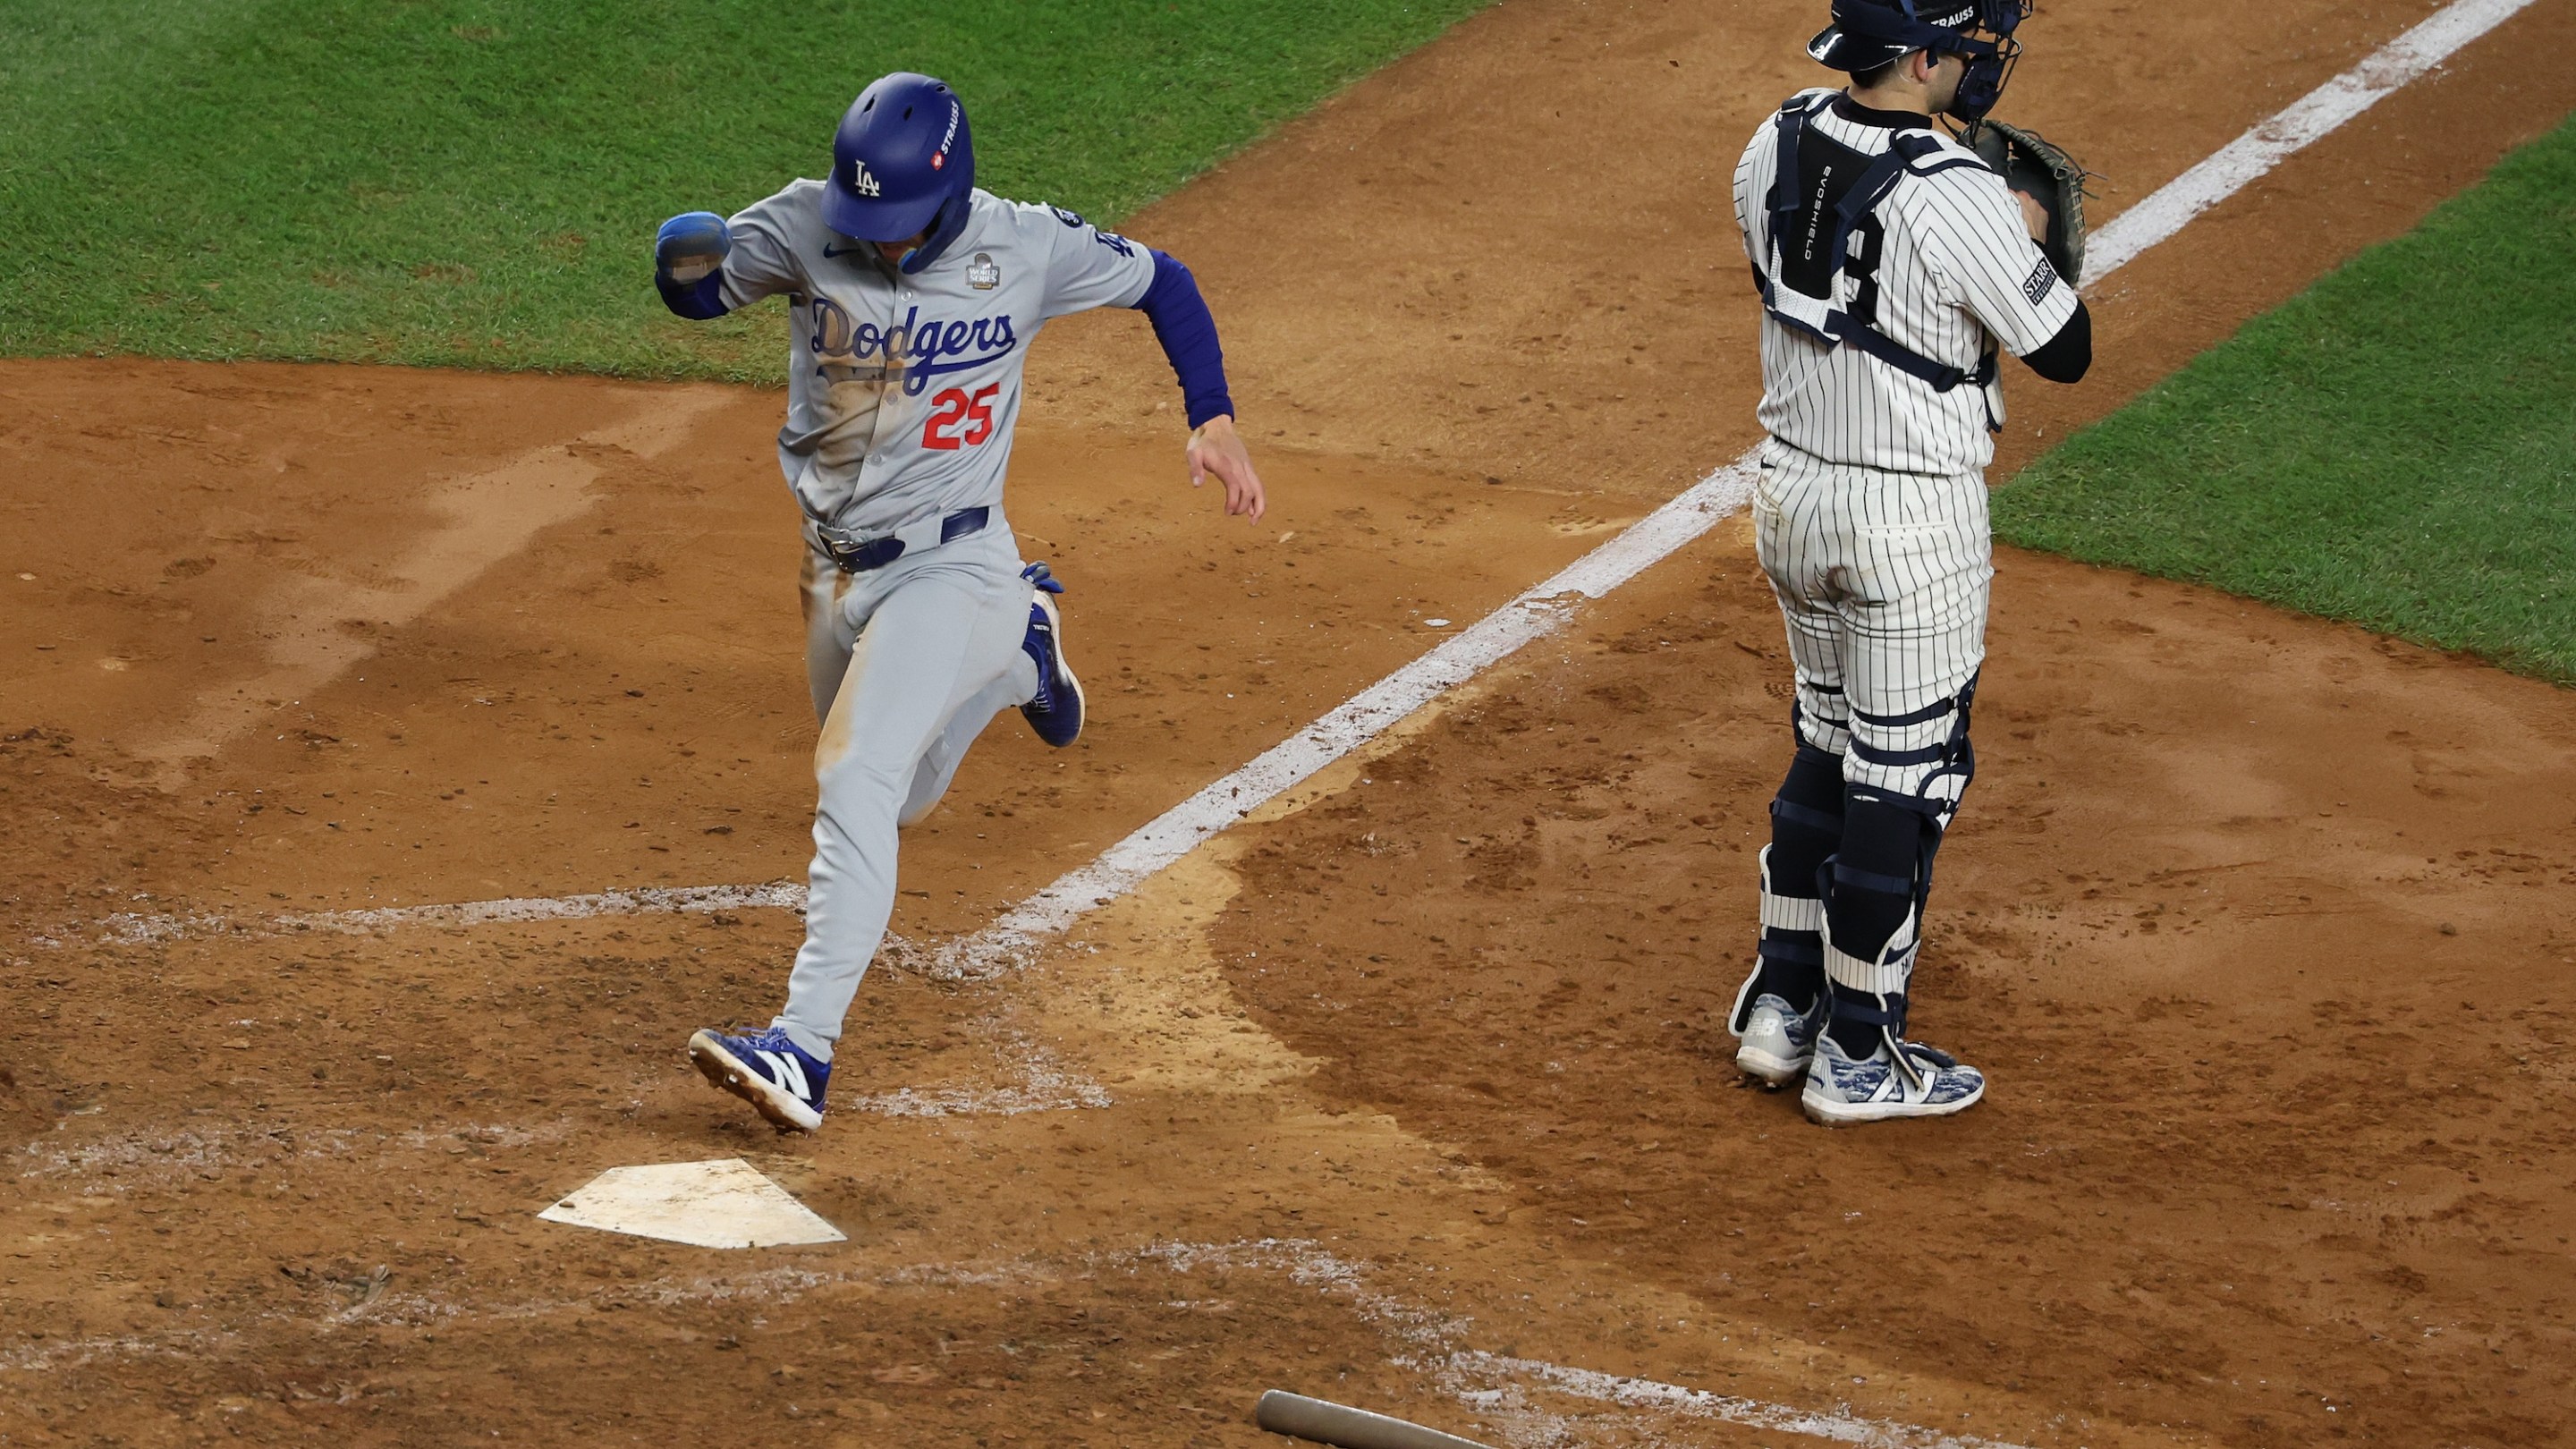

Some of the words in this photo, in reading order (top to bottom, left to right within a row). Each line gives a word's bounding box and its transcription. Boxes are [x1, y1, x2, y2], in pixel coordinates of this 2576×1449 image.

[1930, 5, 1974, 28] TRAUSS
[941, 100, 960, 156] STRAUSS
[855, 159, 880, 197] LA
[1804, 165, 1832, 260] EVOSHIELD
[969, 267, 998, 275] WORLD
[970, 275, 997, 283] SERIES
[2023, 260, 2050, 297] STARR
[811, 299, 1018, 397] Dodgers
[922, 382, 1000, 450] 25
